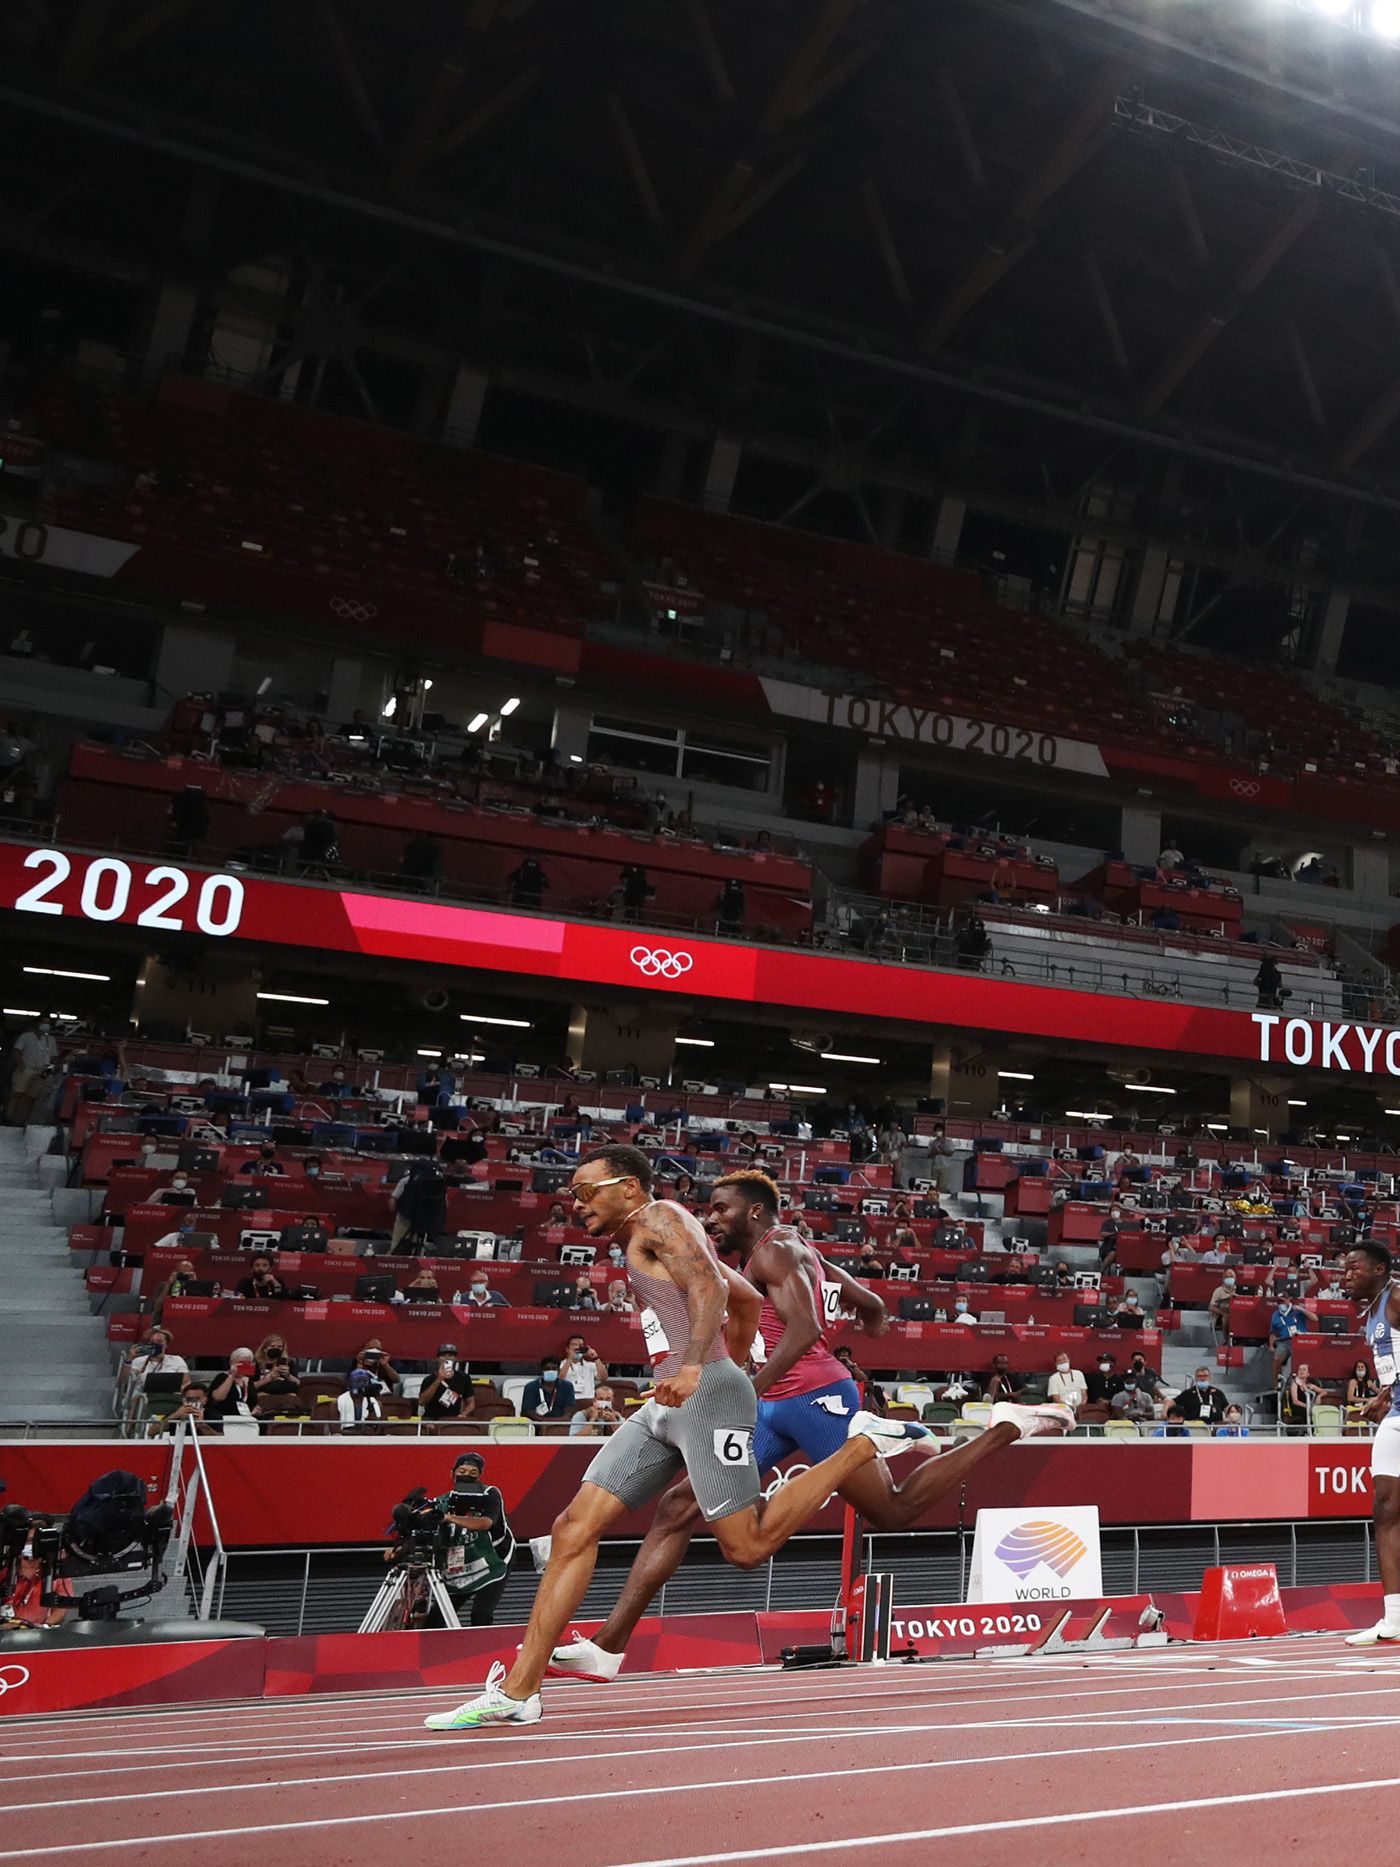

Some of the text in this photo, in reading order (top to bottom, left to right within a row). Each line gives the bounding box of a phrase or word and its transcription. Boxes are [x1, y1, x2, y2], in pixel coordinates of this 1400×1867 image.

[821, 693, 1058, 767] TOKYO 2020
[15, 849, 245, 937] 2020
[723, 1433, 742, 1461] 6
[1315, 1467, 1371, 1494] TOK
[1239, 1569, 1269, 1578] OMEGA
[1016, 1586, 1071, 1600] WORLD
[891, 1613, 1041, 1640] TOKYO 2020
